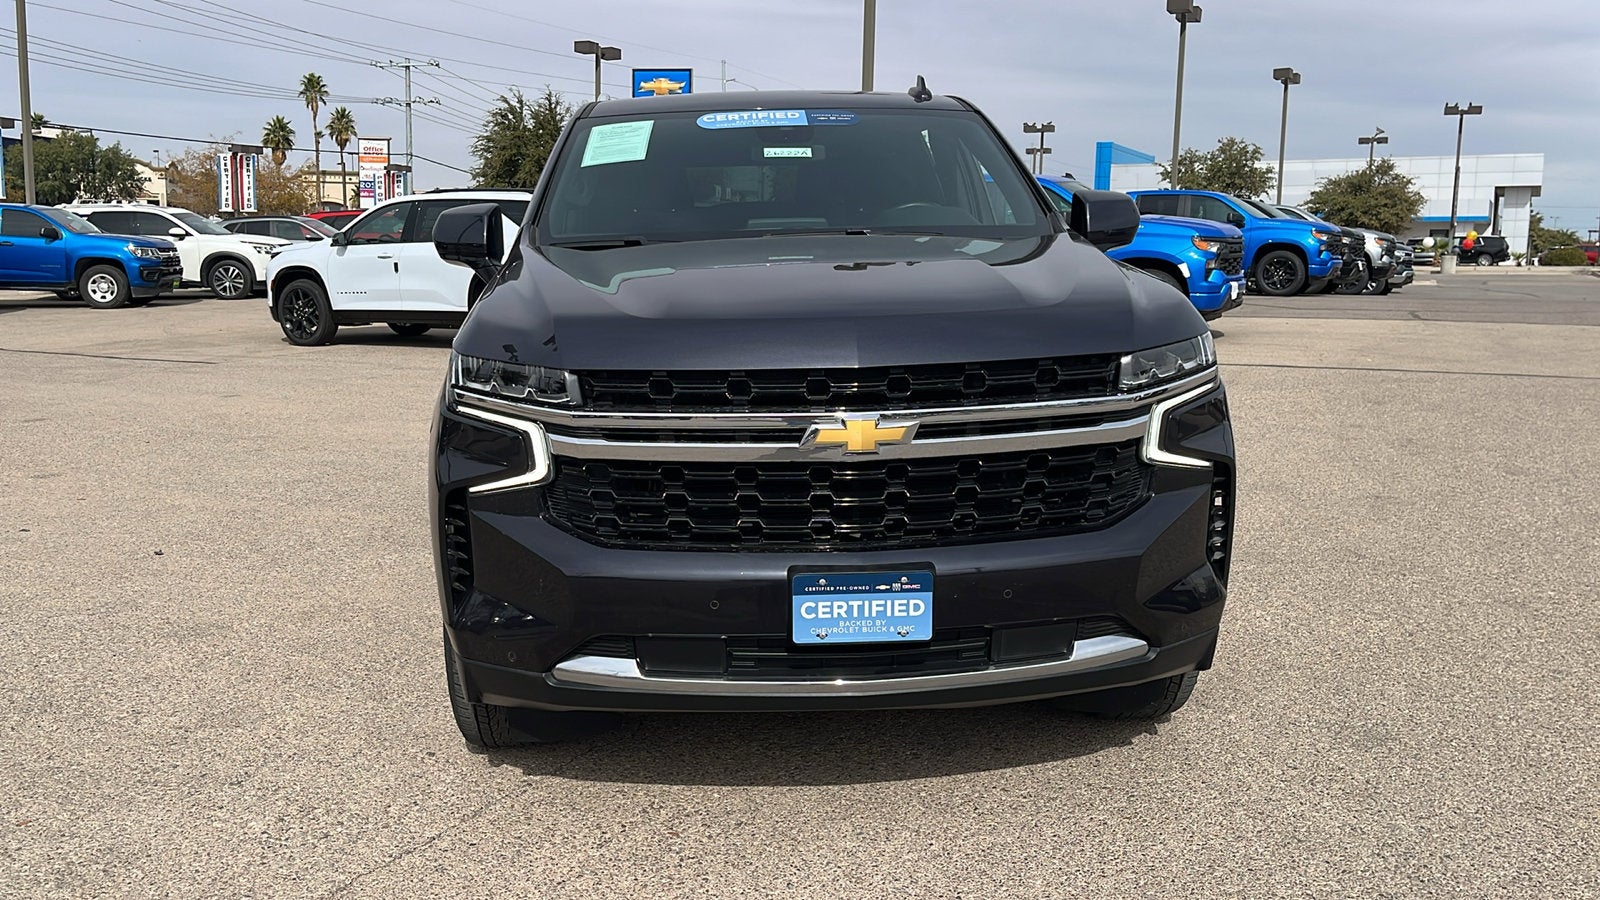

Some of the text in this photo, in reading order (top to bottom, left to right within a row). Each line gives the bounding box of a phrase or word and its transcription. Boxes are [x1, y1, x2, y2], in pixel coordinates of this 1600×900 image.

[702, 112, 800, 122] CERTIFIED
[800, 599, 925, 619] CERTIFIED
[810, 626, 859, 634] CHEVROLET
